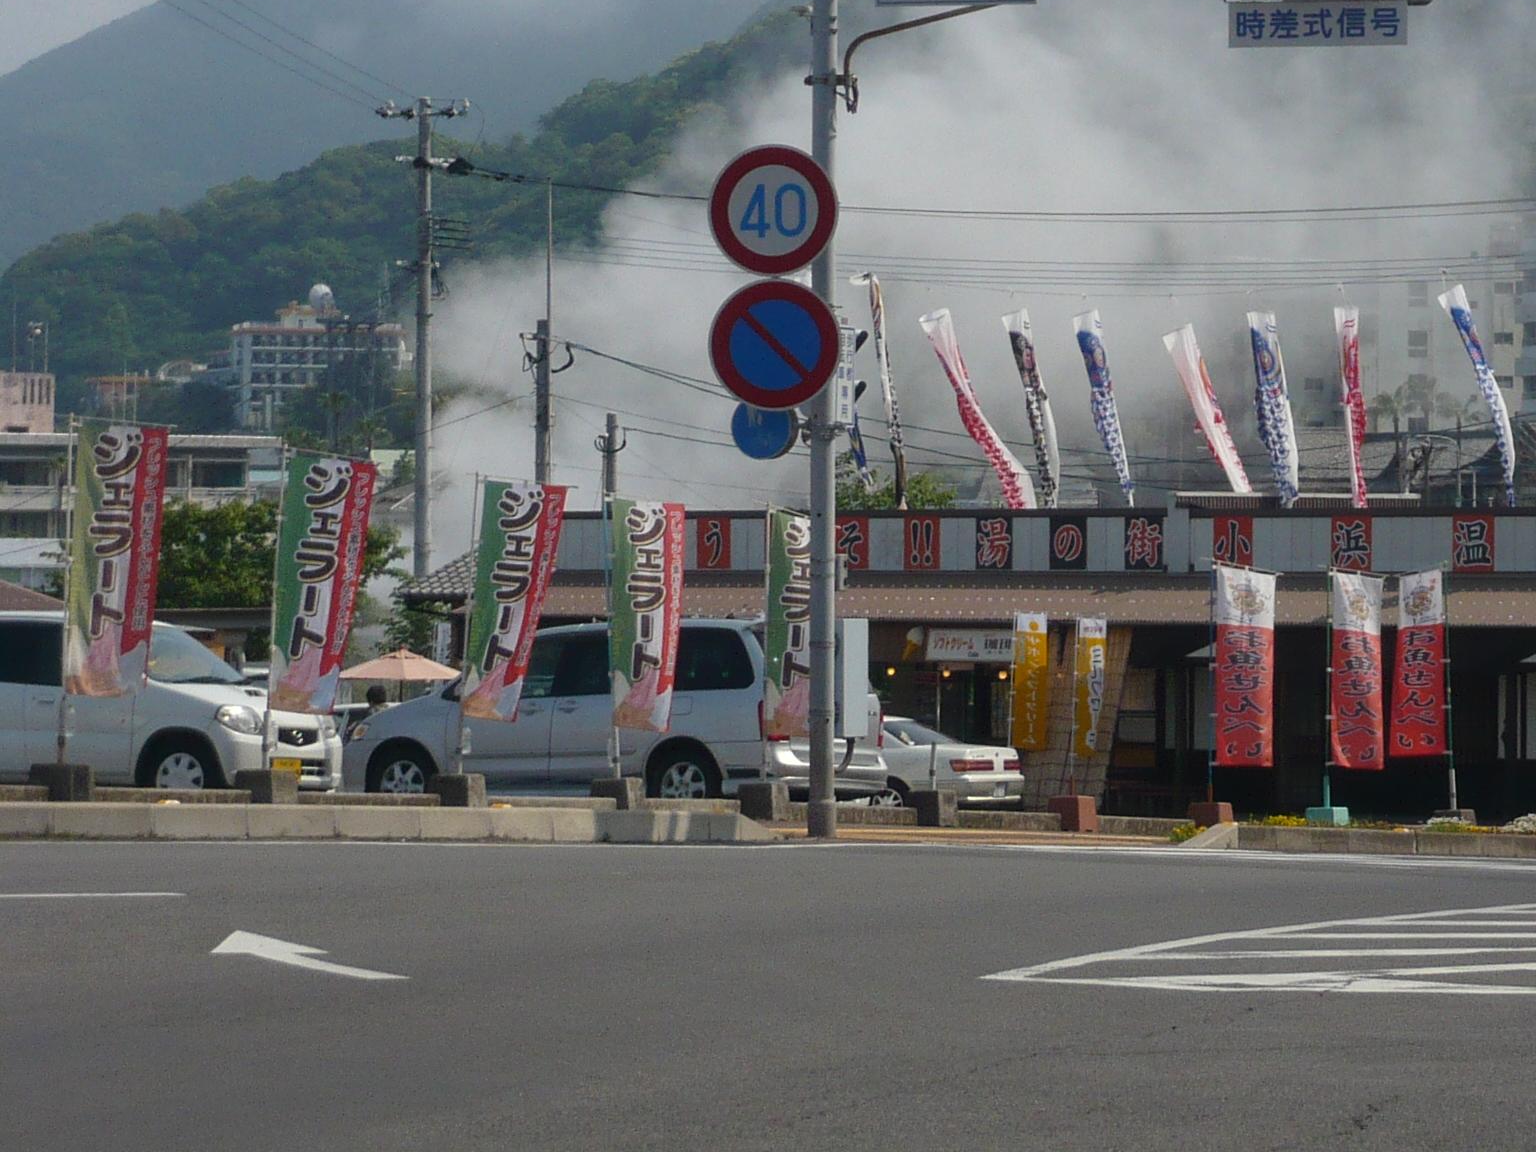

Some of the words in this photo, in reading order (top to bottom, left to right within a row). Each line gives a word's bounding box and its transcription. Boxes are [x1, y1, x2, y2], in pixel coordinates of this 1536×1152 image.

[1236, 7, 1400, 40] 時差式信号
[739, 183, 808, 239] 40
[89, 431, 144, 641] ジェラート
[289, 462, 354, 662] ジェラート
[481, 487, 545, 674] ジェラート
[625, 506, 667, 682] ジェラート
[1397, 628, 1440, 750] お魚せんべい
